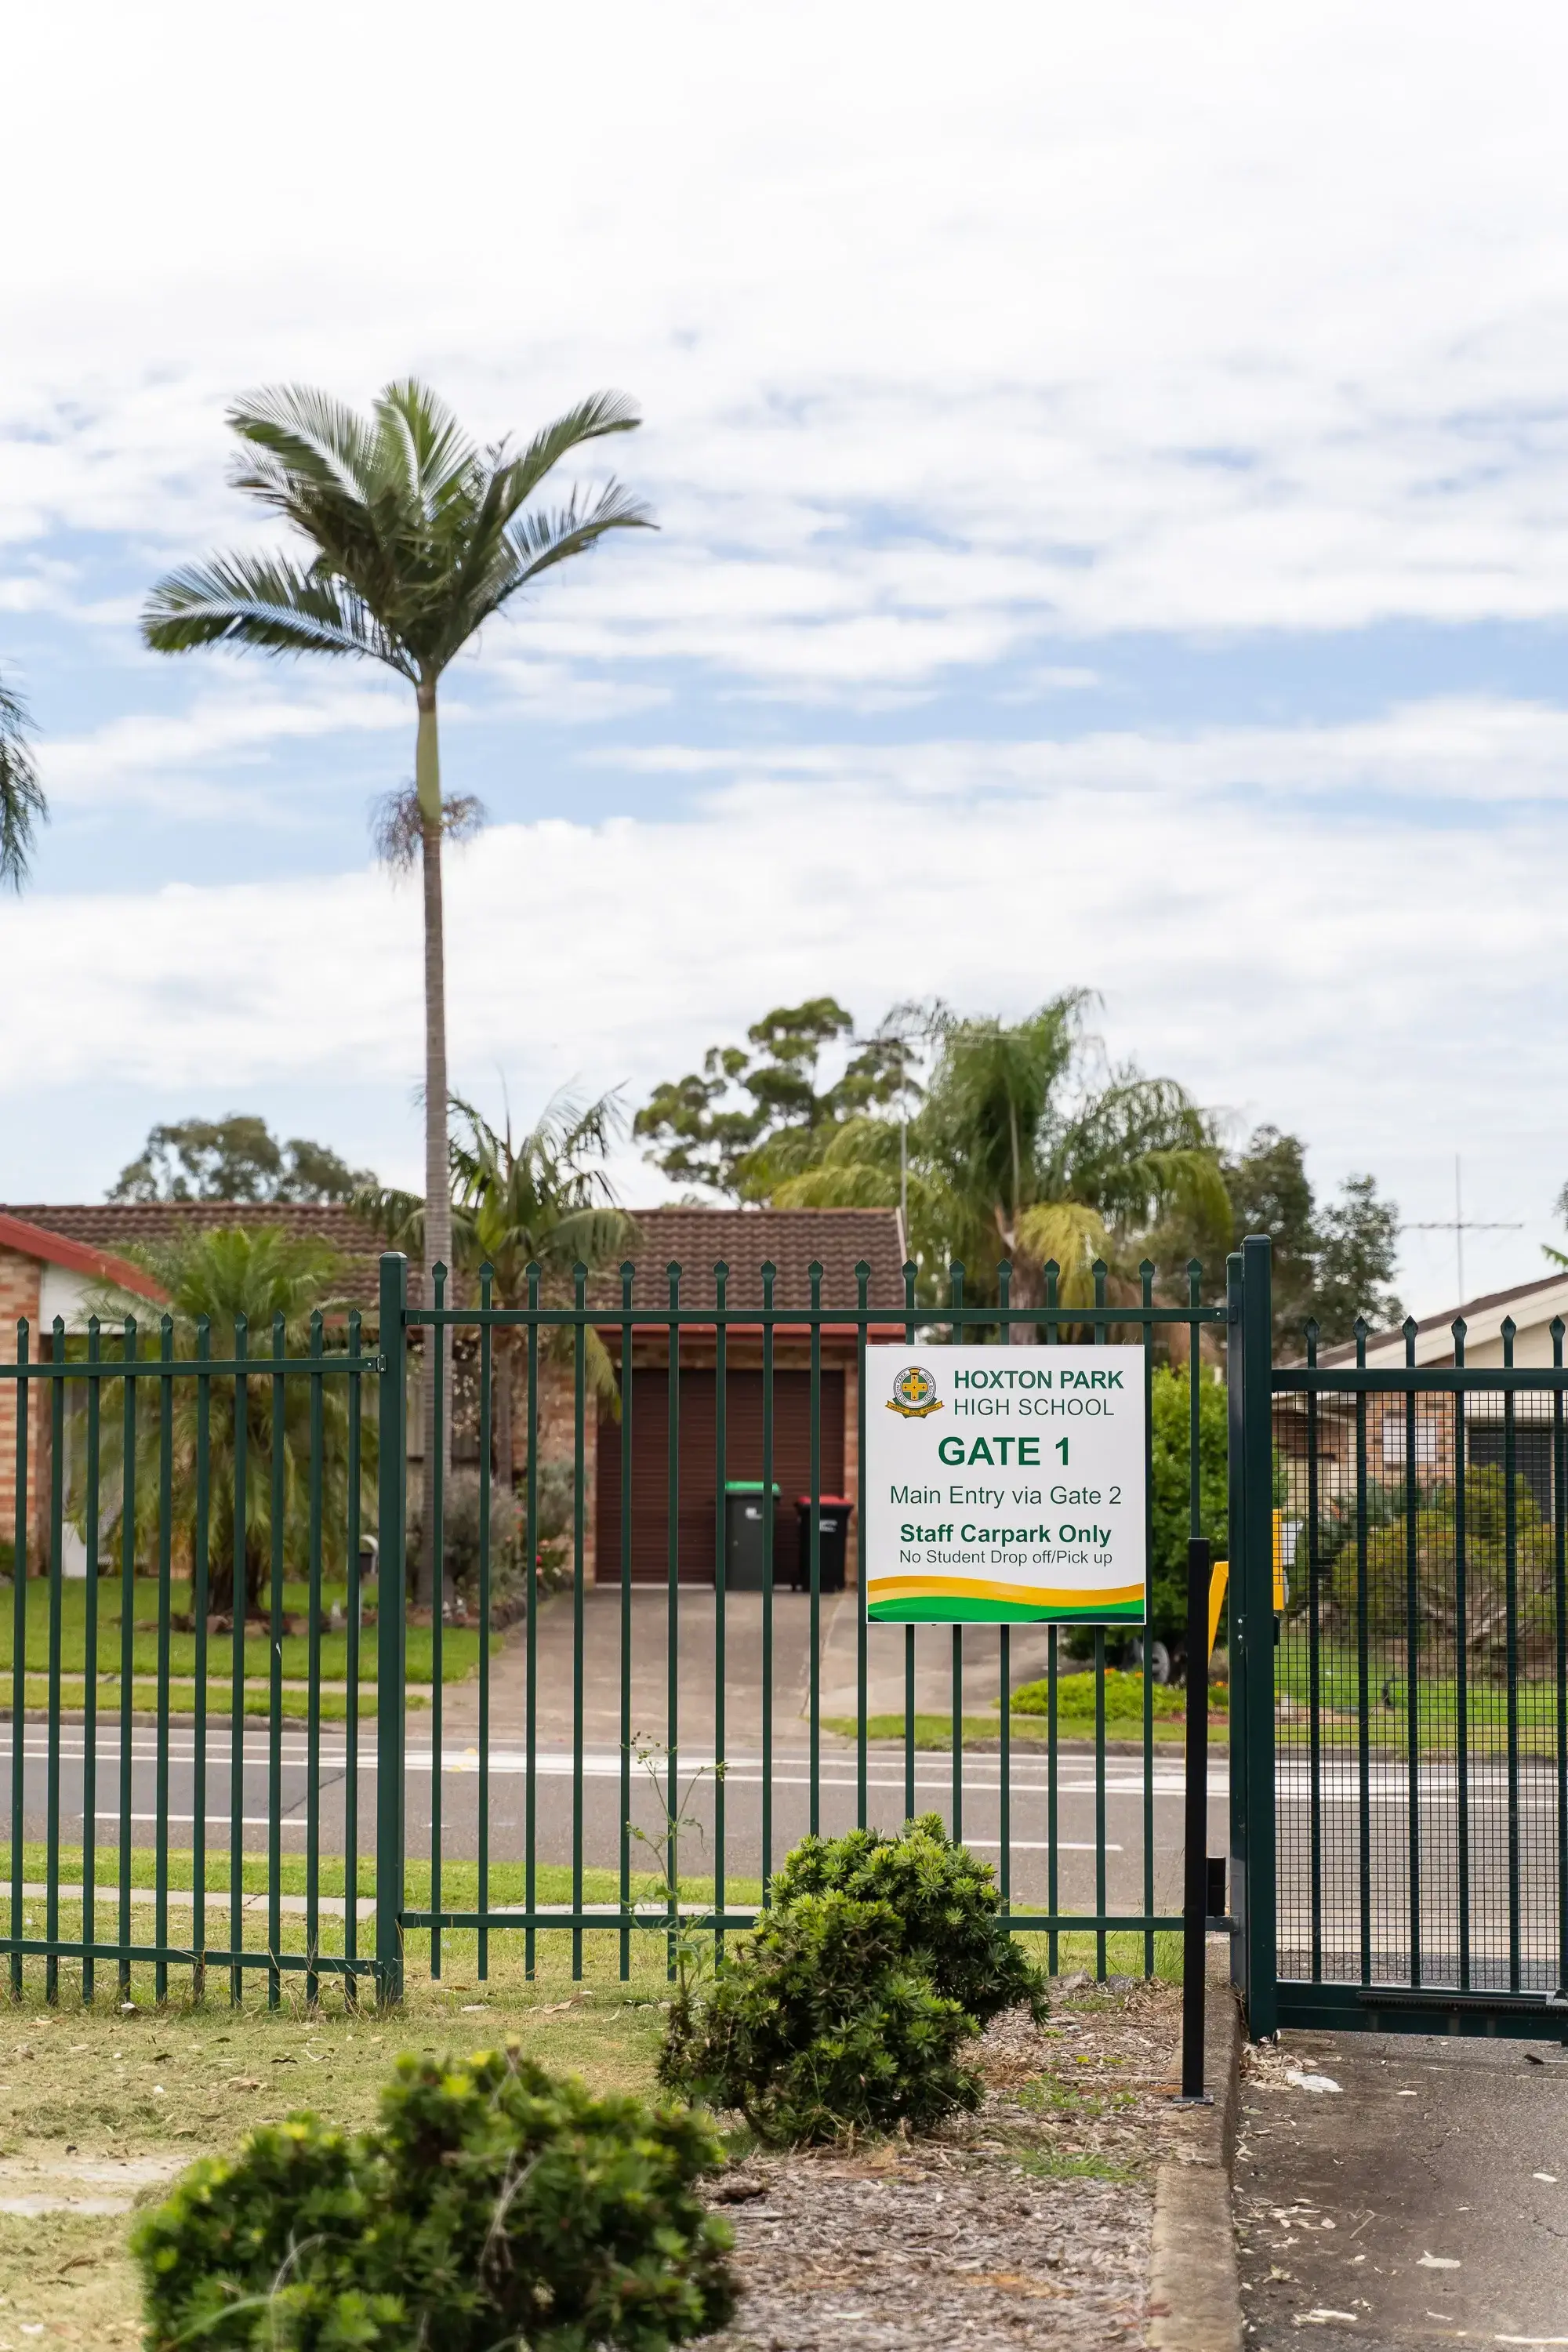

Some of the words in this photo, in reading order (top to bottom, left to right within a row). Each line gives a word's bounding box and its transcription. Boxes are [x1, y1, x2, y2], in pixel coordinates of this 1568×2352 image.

[897, 1373, 907, 1384] PARK
[955, 1370, 1051, 1388] HOXTON
[1061, 1371, 1124, 1388] PARK
[955, 1399, 1009, 1415] HIGH
[1019, 1399, 1114, 1415] SCHOOL
[938, 1437, 1040, 1465] GATE
[1056, 1437, 1069, 1465] 1
[891, 1486, 941, 1504] Main
[950, 1486, 1004, 1508] Entry
[1012, 1486, 1041, 1504] via
[1051, 1486, 1101, 1504] Gate
[1109, 1486, 1121, 1504] 2
[901, 1524, 954, 1542] Staff
[961, 1524, 1051, 1547] Carpark
[1059, 1525, 1112, 1548] Only
[900, 1550, 920, 1563] No
[927, 1550, 985, 1563] Student
[992, 1551, 1027, 1566] Drop
[1033, 1550, 1088, 1564] off/Pick
[1094, 1554, 1112, 1566] up
